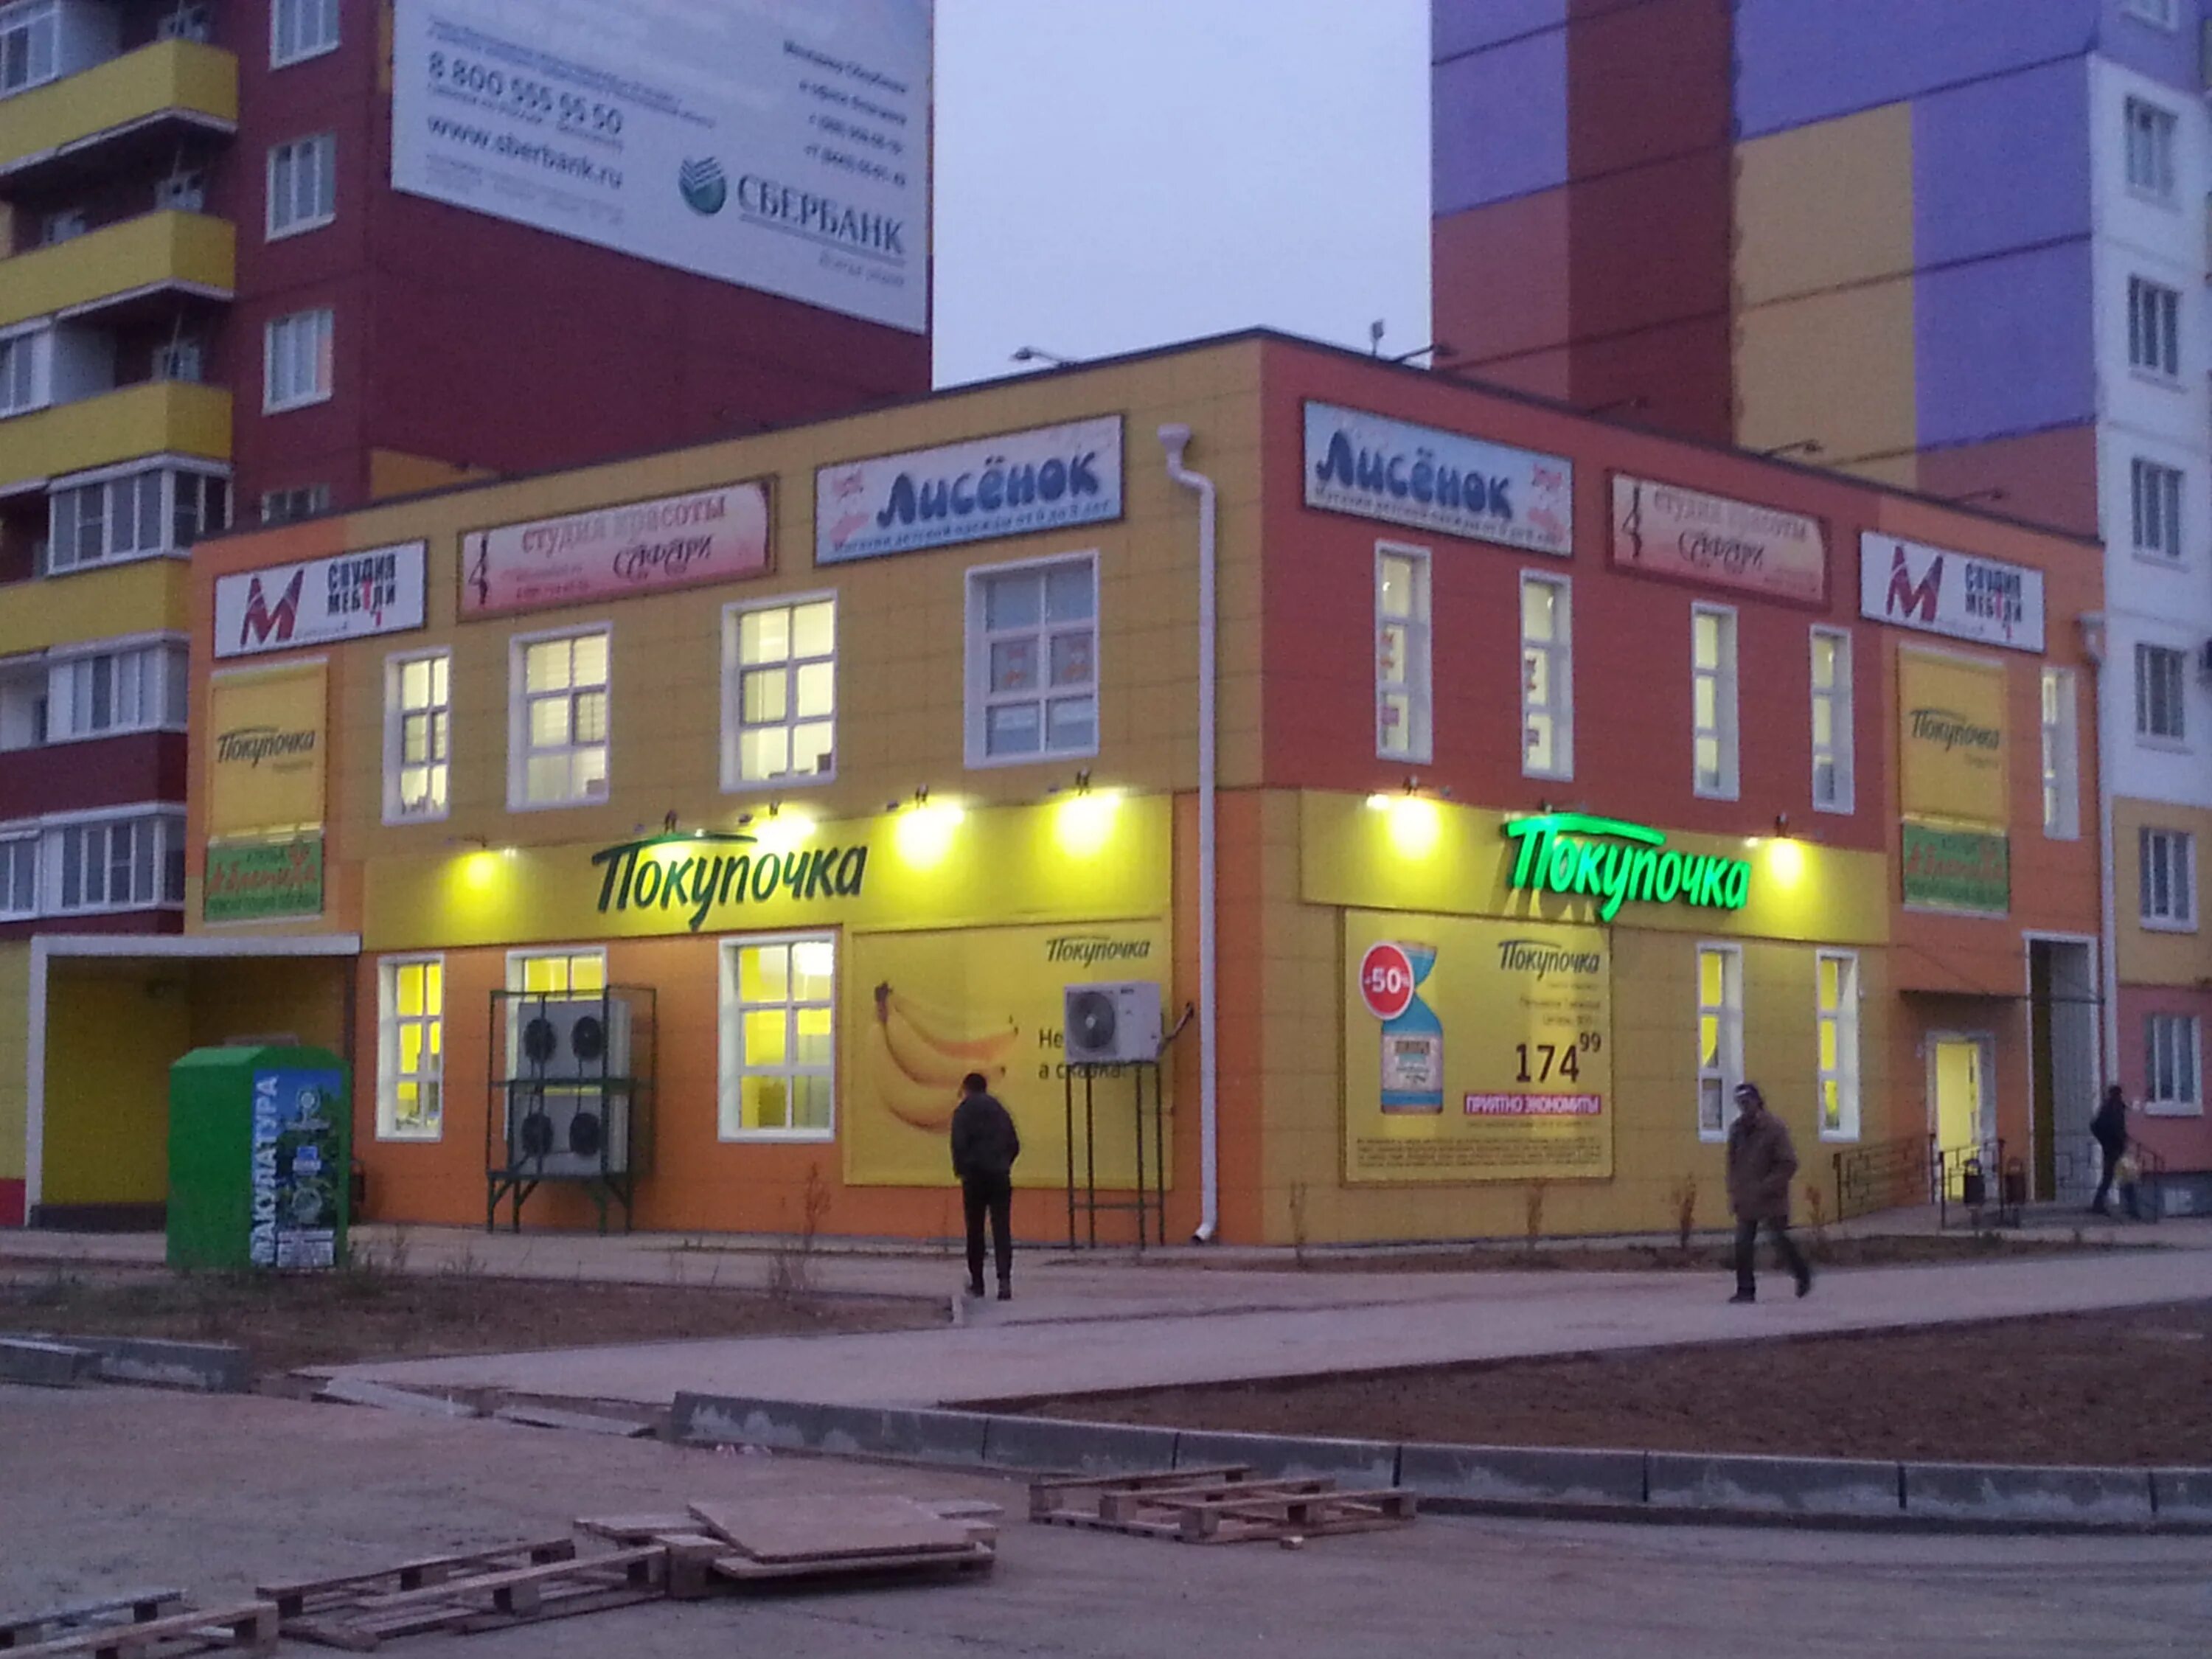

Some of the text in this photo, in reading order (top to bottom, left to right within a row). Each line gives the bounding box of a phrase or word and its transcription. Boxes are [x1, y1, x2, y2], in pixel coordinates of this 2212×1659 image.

[429, 50, 445, 78] 8
[452, 58, 504, 97] 800
[428, 115, 624, 190] www.sberbank.ru
[738, 174, 905, 255] СБЕРБАНК
[877, 451, 1100, 528] Лисёнок
[1316, 428, 1514, 519] Лисёнок
[218, 725, 316, 769] Покупочка
[1910, 708, 2000, 752] Покупочка
[591, 832, 868, 932] Покупочка
[1505, 812, 1751, 922] Покупочка
[1046, 935, 1151, 969] Покупочка
[1498, 939, 1601, 982] Покупочка
[1038, 1062, 1048, 1080] а
[1515, 1032, 1602, 1084] 174 99
[251, 1076, 279, 1265] МАКУЛАТУРА
